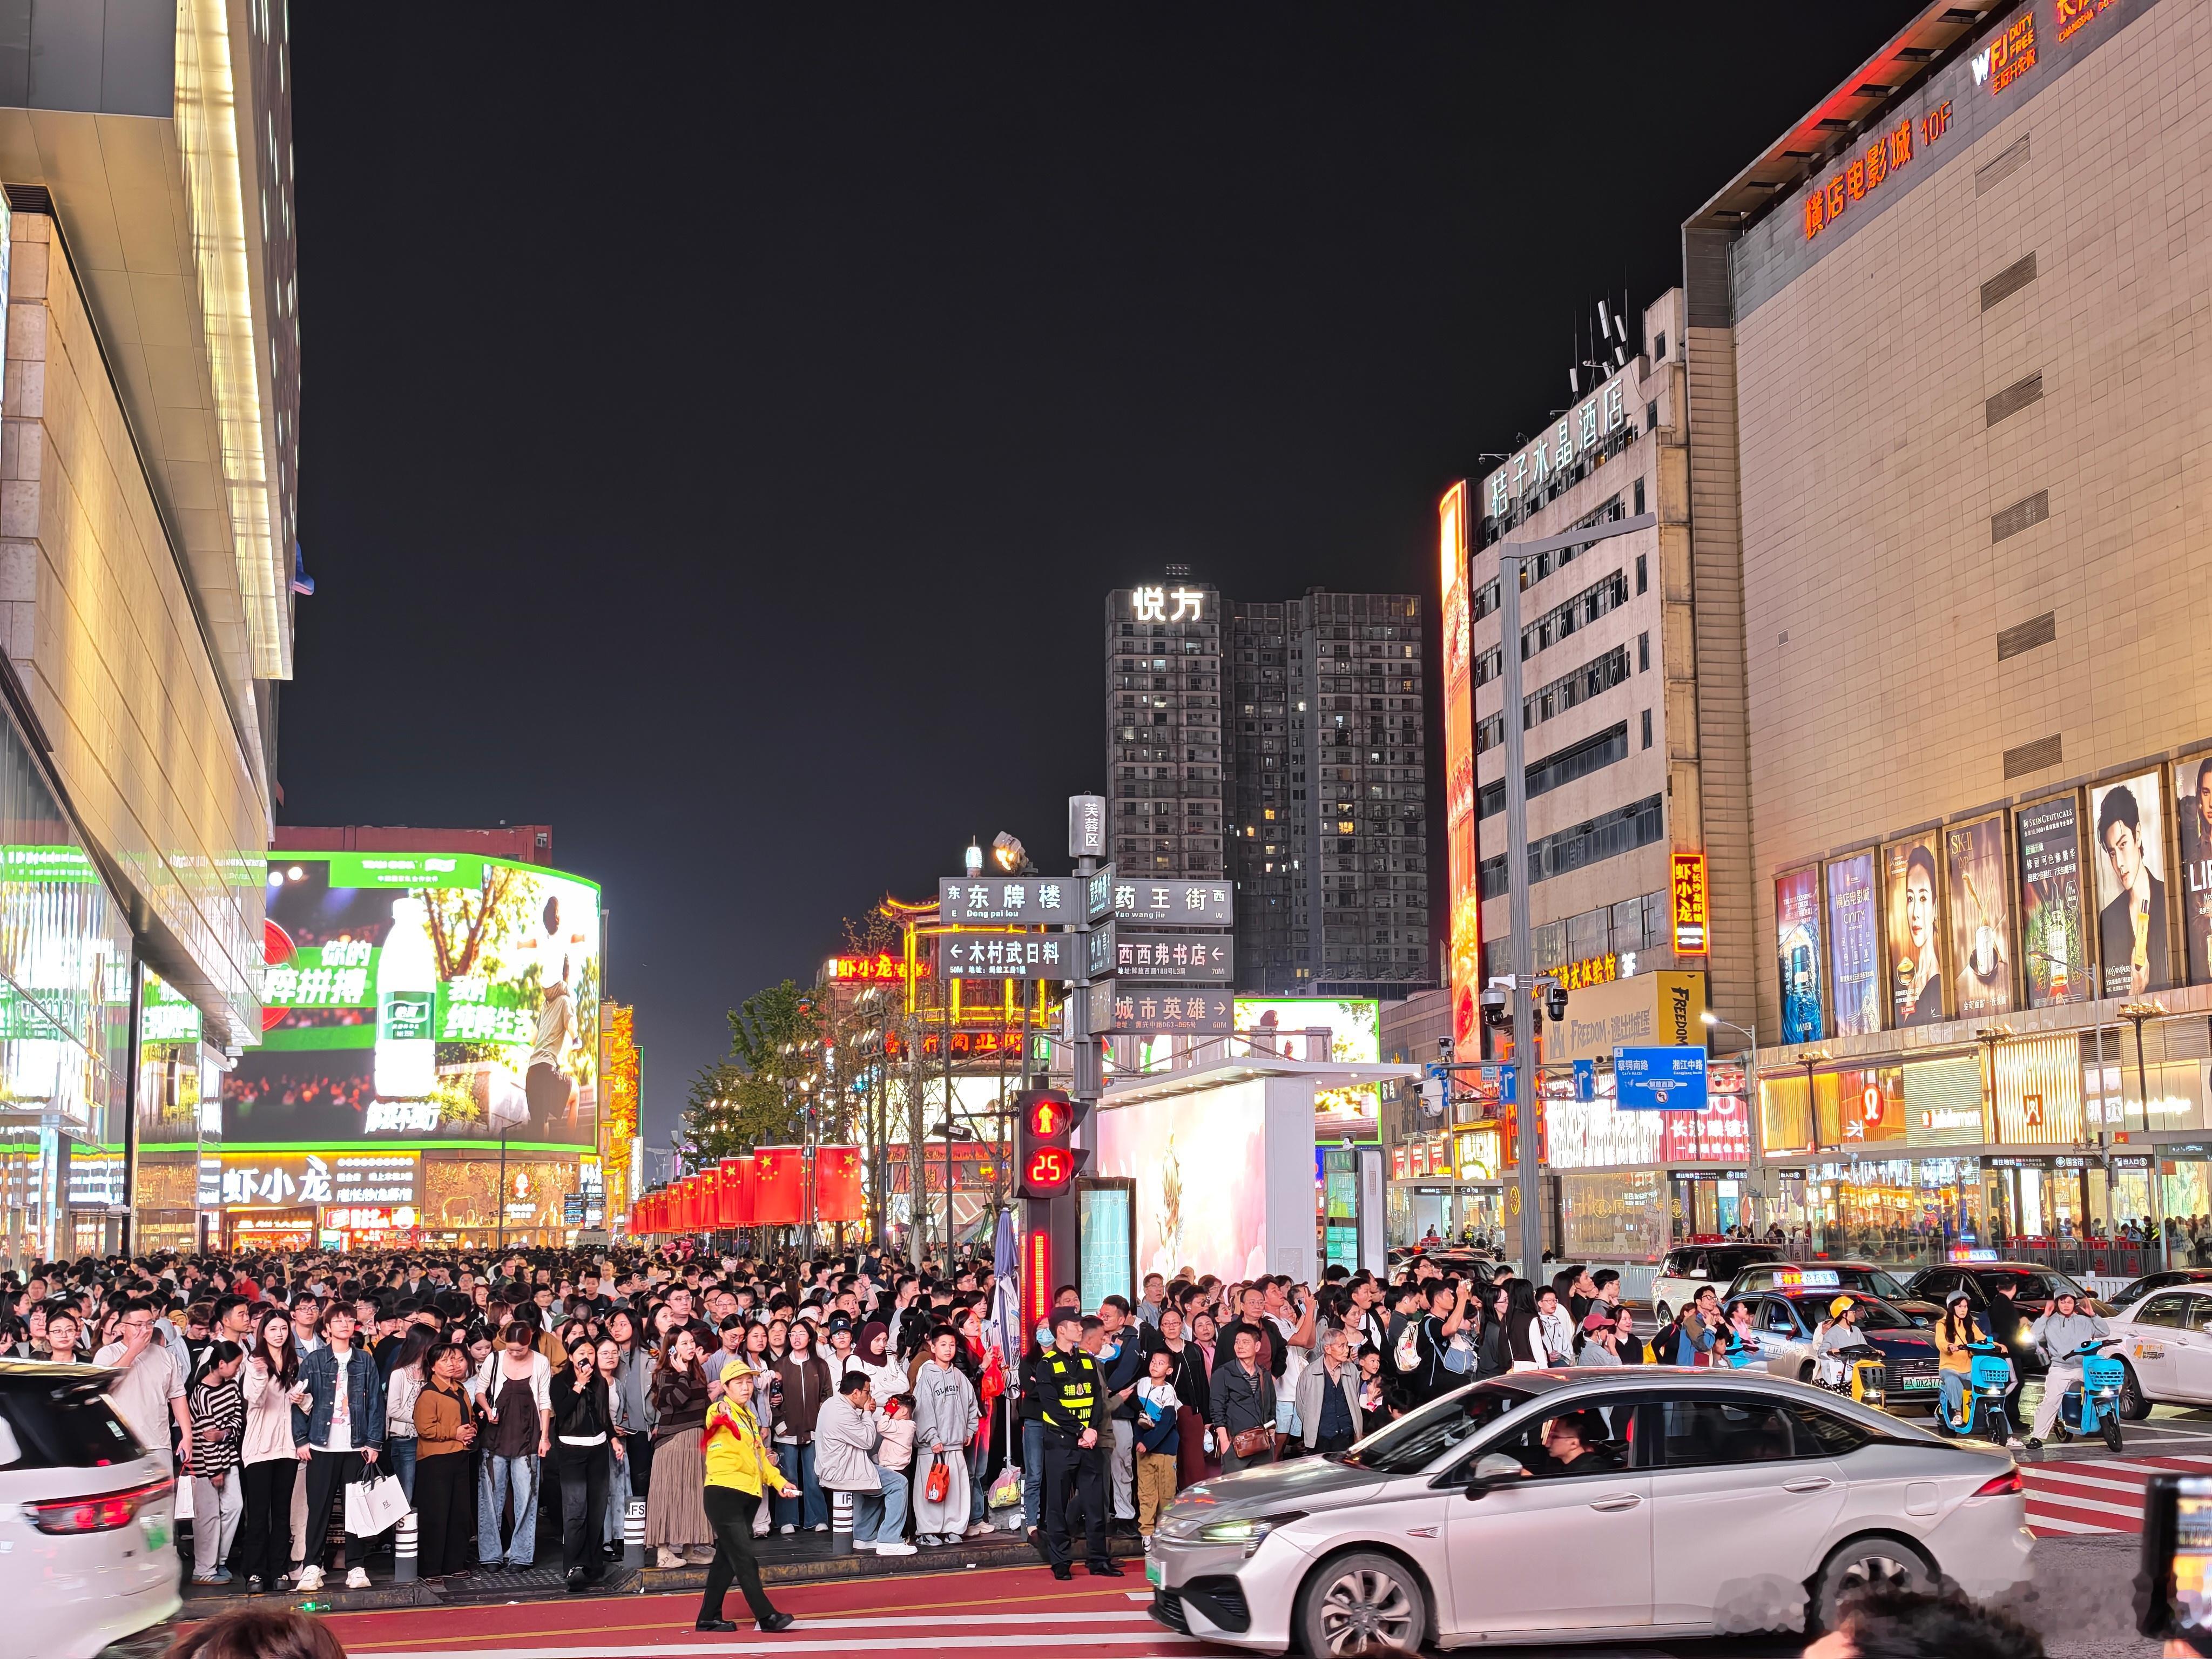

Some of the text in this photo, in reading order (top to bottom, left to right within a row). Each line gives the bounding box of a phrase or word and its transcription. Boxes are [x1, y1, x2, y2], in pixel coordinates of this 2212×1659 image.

[2009, 12, 2033, 42] DUTY
[2010, 29, 2034, 58] FREE
[1972, 33, 2008, 86] WFJ
[1805, 100, 1952, 240] 横店电影城 10F
[1491, 378, 1623, 518] 桔子水晶酒店
[1132, 586, 1204, 622] 悦方
[1084, 802, 1099, 847] 芙蓉区
[948, 885, 1061, 909] 东 东牌楼
[1115, 885, 1207, 911] 药王街
[1212, 889, 1225, 902] 西
[1675, 863, 1693, 922] 虾小龙
[1836, 886, 1871, 909] 横店电影城
[967, 910, 989, 918] Dong
[1155, 911, 1165, 919] jie
[838, 954, 892, 978] 虾小龙
[969, 941, 1060, 965] 木村武日料
[1118, 943, 1206, 966] 西西弗书店
[1115, 996, 1206, 1020] 城市英雄
[1671, 987, 1689, 1046] FREEDOM
[1570, 1019, 1607, 1053] FREEDOM
[1617, 1059, 1703, 1071] 蔡锷南路 湘江中路
[223, 1155, 332, 1204] 虾小龙
[1031, 1154, 1060, 1182] 25
[1078, 1407, 1092, 1419] JIN
